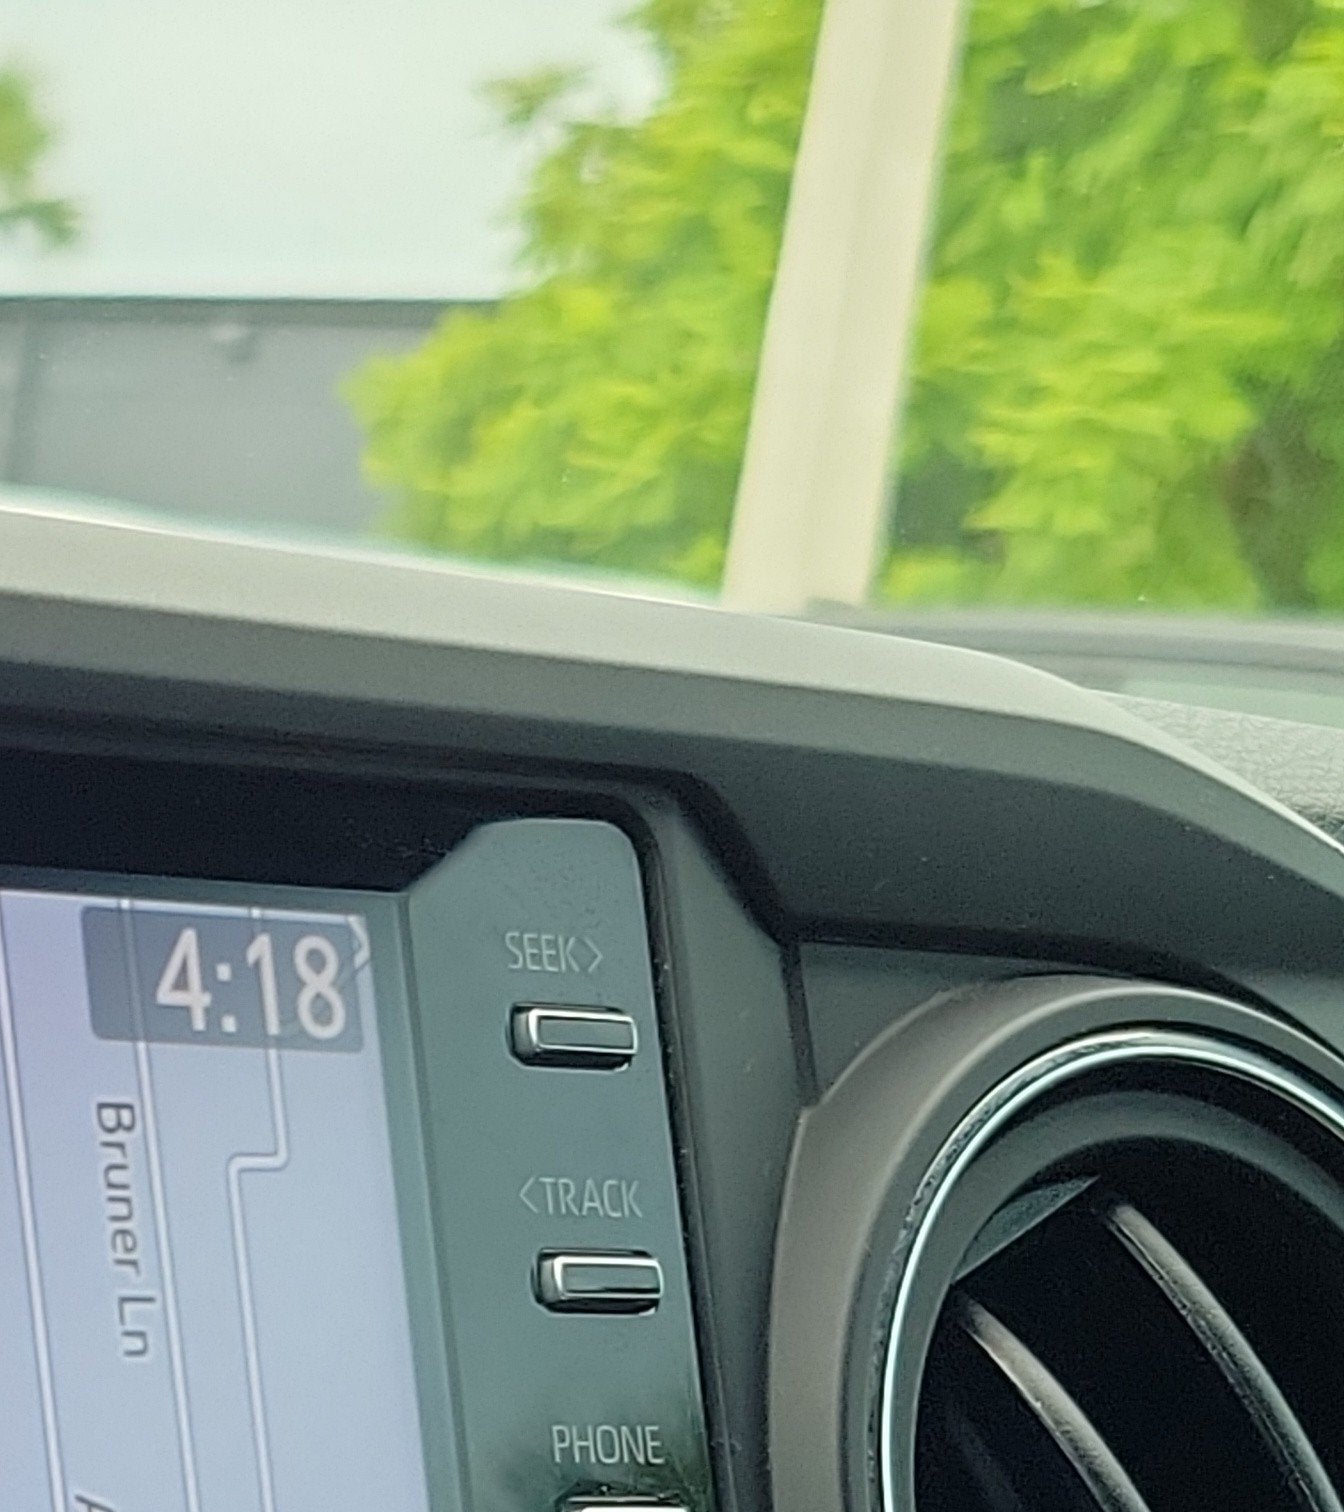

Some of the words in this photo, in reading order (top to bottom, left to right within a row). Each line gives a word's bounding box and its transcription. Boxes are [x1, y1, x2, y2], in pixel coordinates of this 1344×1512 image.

[155, 927, 347, 1040] 4:18
[95, 1099, 141, 1276] Bruner
[117, 1293, 157, 1359] Ln
[552, 1424, 666, 1466] PHONE
